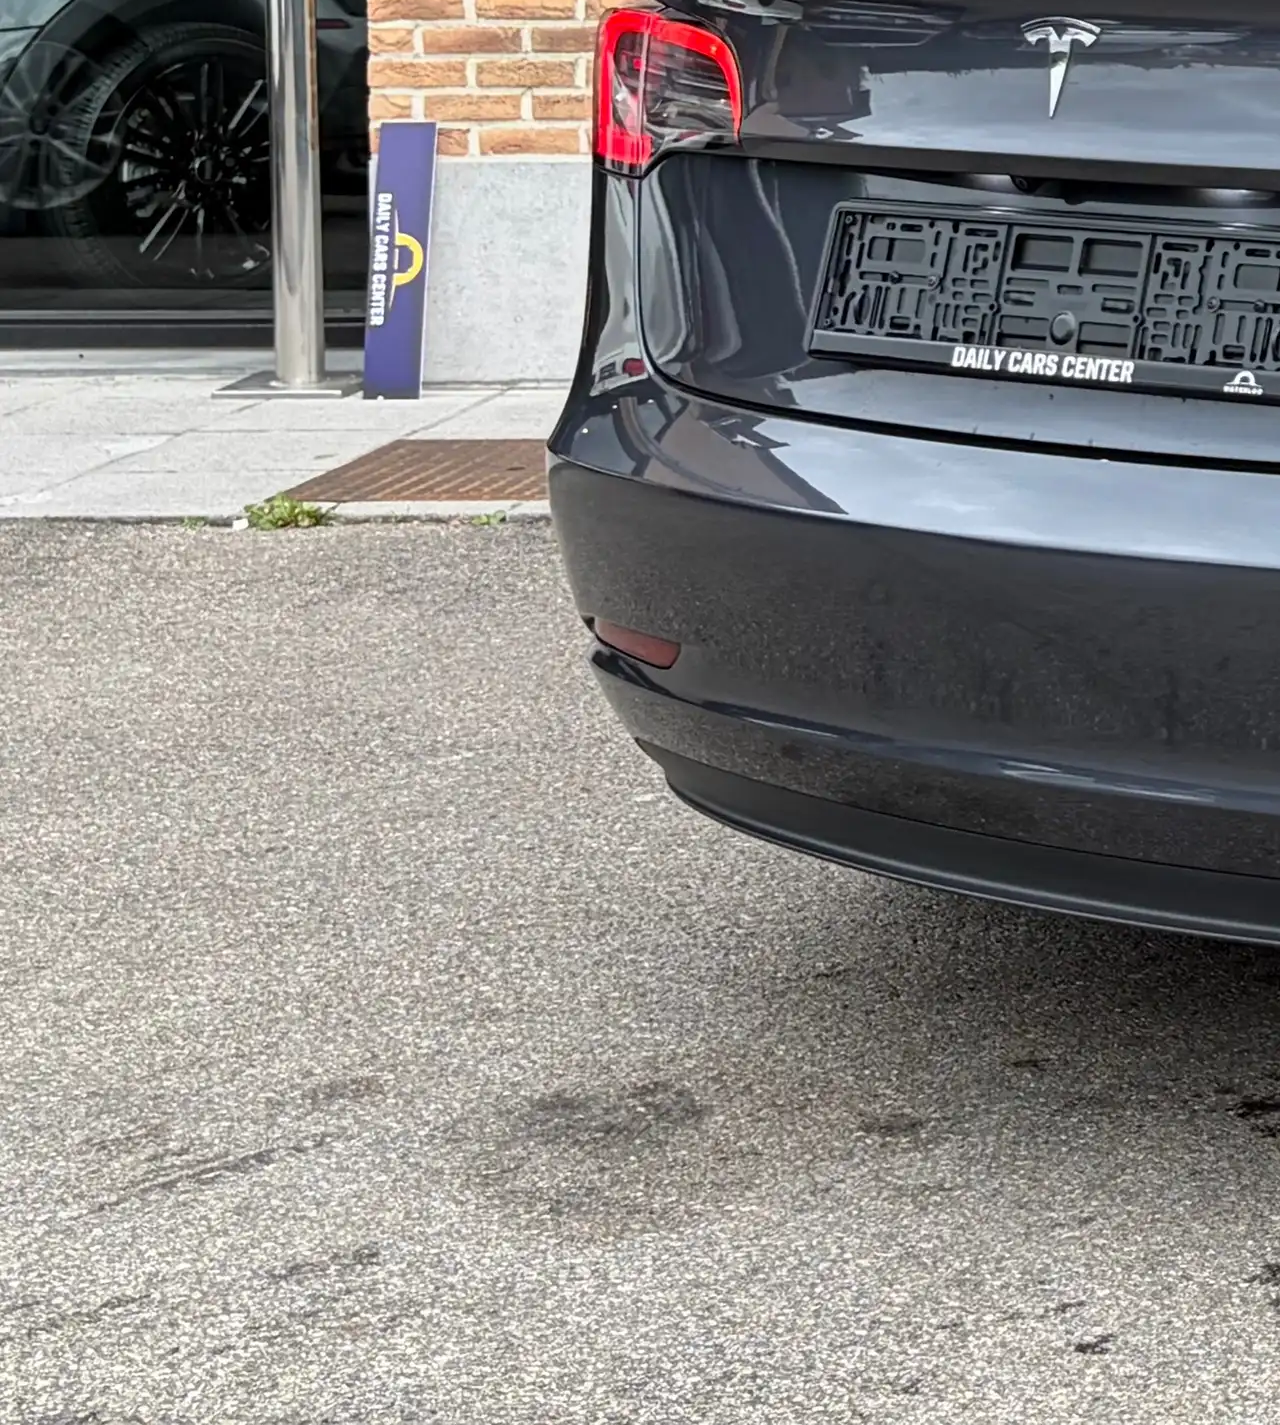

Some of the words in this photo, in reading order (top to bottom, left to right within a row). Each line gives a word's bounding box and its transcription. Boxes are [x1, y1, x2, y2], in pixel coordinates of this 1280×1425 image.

[375, 192, 393, 233] DAILY
[372, 234, 390, 272] CARS
[369, 273, 387, 327] CENTER
[951, 346, 1005, 371] DAILY
[1007, 351, 1059, 377] CARS
[1061, 355, 1135, 384] CENTER
[1223, 385, 1264, 396] WATERLOO
